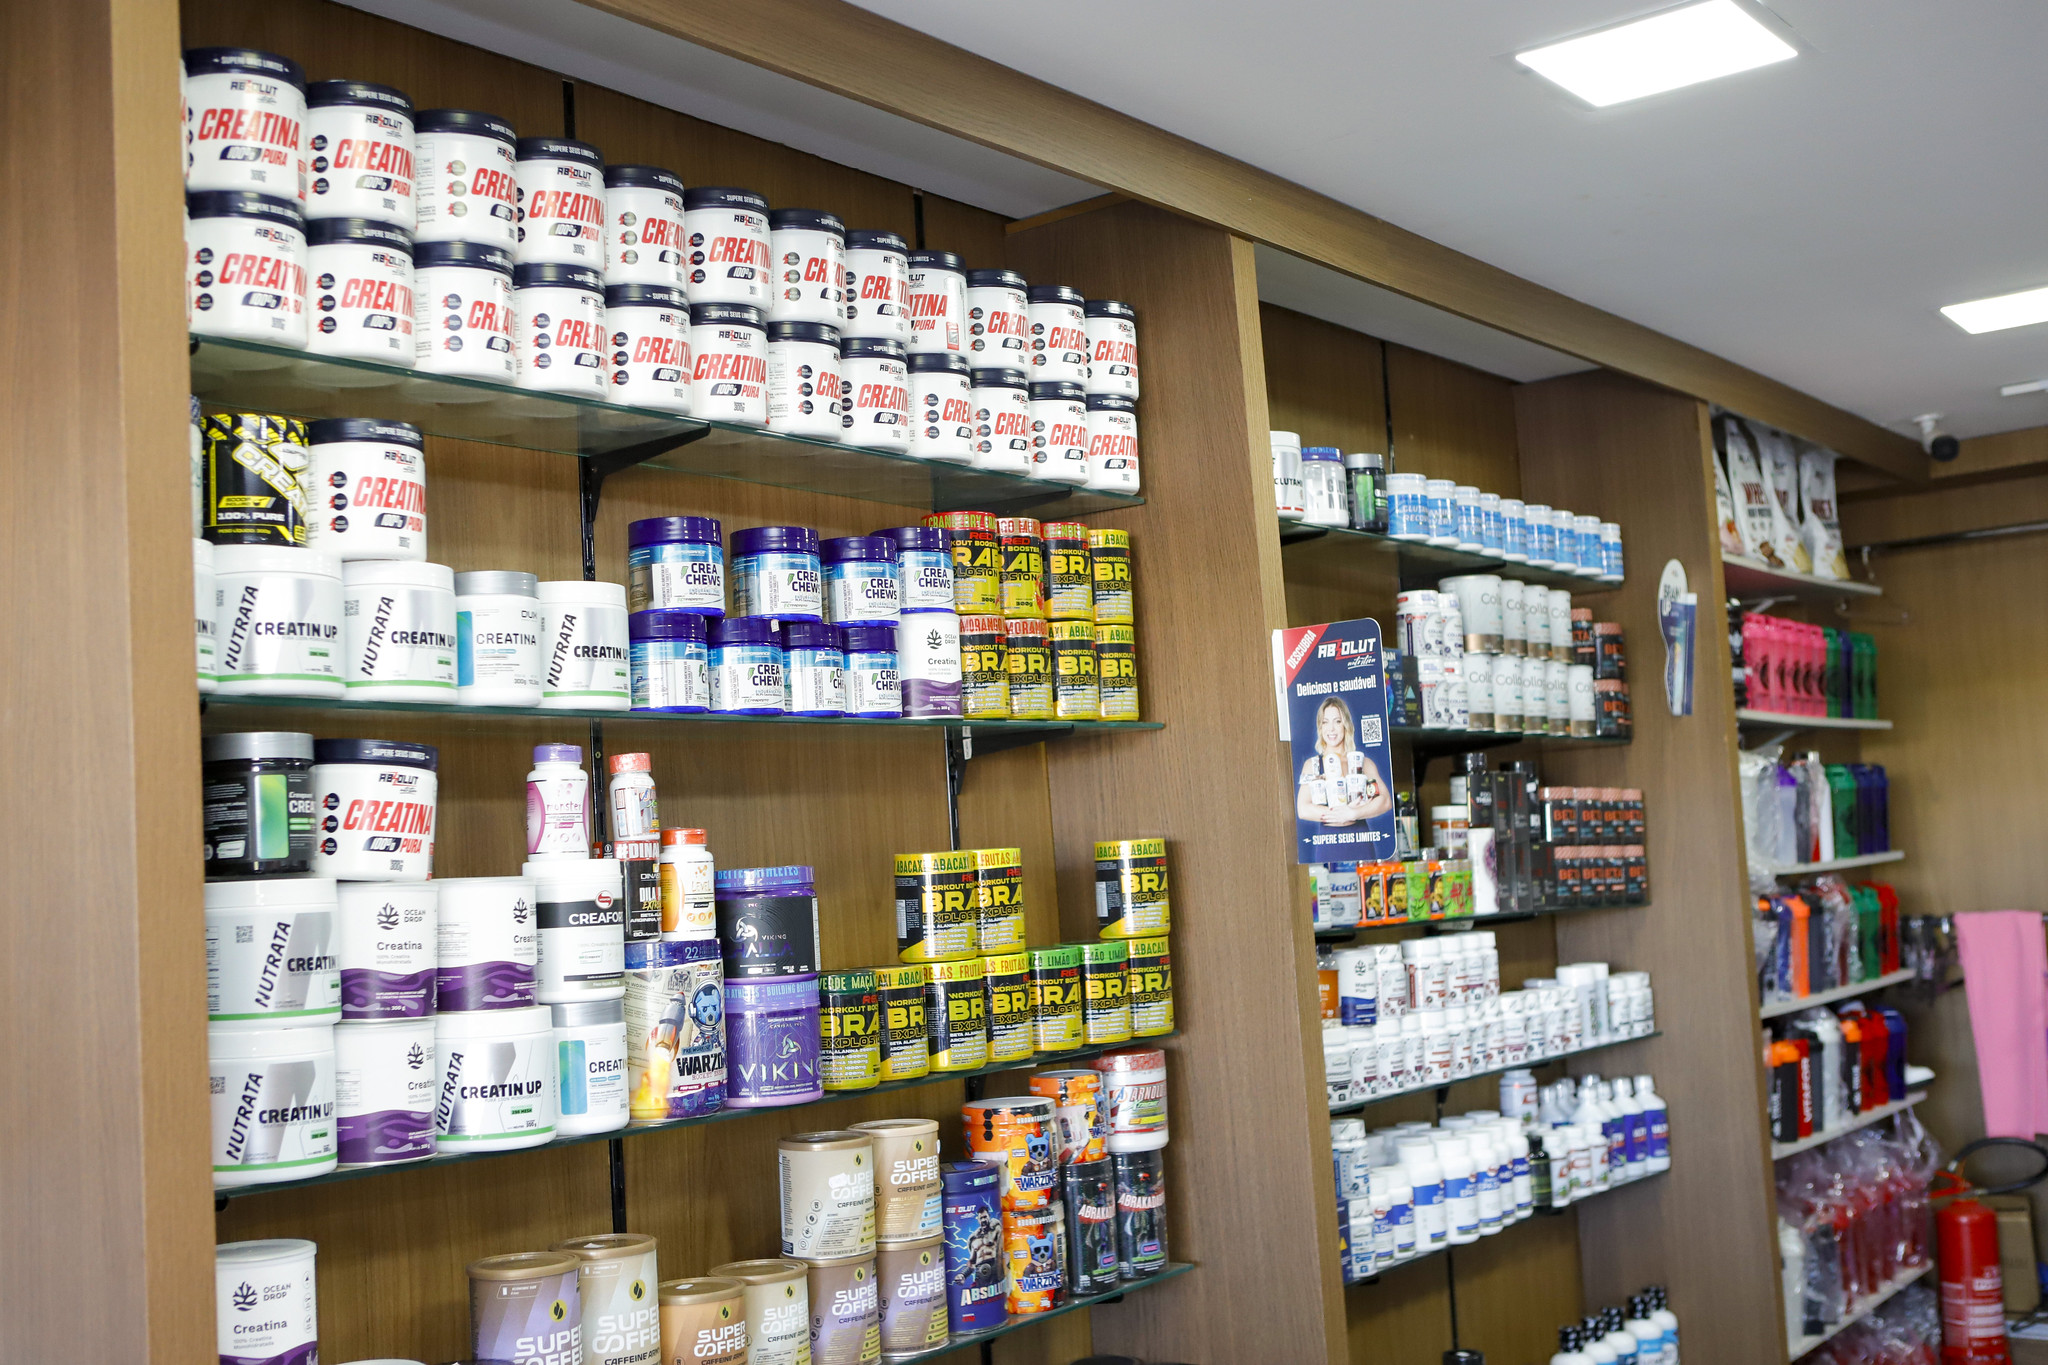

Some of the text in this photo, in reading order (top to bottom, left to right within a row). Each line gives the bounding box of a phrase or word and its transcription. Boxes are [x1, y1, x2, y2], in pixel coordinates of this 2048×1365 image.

[199, 108, 299, 151] CREATINA
[261, 149, 286, 167] PURA
[693, 354, 766, 385] CREATINA
[741, 385, 759, 399] PURA
[217, 512, 285, 521] 100% PURE
[929, 515, 981, 529] CRANBERRY
[969, 532, 993, 540] RED
[691, 563, 717, 574] CREA
[923, 568, 947, 578] CREA
[685, 574, 721, 586] CHEWS
[797, 571, 818, 581] CREA
[919, 578, 950, 588] CHEWS
[792, 581, 820, 593] CHEWS
[870, 579, 894, 588] CREA
[866, 588, 897, 599] CHEWS
[224, 585, 259, 670] NUTRATA
[255, 622, 338, 638] CREATIN UP
[361, 596, 394, 676] NUTRATA
[391, 630, 446, 648] CREATIN
[476, 633, 536, 645] CREATINA
[547, 614, 576, 687] NUTRATA
[574, 645, 621, 659] CREATIN
[1286, 629, 1316, 670] DESCUBRA
[758, 665, 780, 674] CREA
[880, 670, 898, 679] CREA
[753, 675, 782, 686] CHEWS
[876, 680, 901, 690] CHEWS
[1297, 675, 1376, 697] Delicioso e saudável!
[343, 799, 433, 835] CREATINA
[1313, 831, 1380, 845] SUPERE SEUS LIMITES
[400, 839, 422, 853] PURA
[981, 852, 1010, 866] FRUTAS
[377, 942, 422, 951] Creatina
[685, 947, 698, 959] 22
[254, 921, 292, 1009] NUTRATA
[1001, 958, 1026, 973] FRUTAS
[1048, 952, 1070, 966] LIMÃO
[1086, 972, 1117, 980] WORKOUT
[992, 984, 1025, 993] WORKOUT
[436, 1052, 464, 1131] NUTRATA
[461, 1080, 542, 1100] CREATIN UP
[226, 1072, 263, 1160] NUTRATA
[259, 1104, 320, 1124] CREATIN
[893, 1155, 938, 1173] SUPER
[891, 1167, 939, 1185] COFFEE
[897, 1185, 925, 1193] CAFFEINE
[837, 1199, 864, 1208] CAFFEINE
[901, 1267, 944, 1286] SUPER
[263, 1283, 291, 1293] OCEAN
[897, 1281, 945, 1298] COFFEE
[263, 1291, 287, 1301] DROP
[904, 1298, 932, 1306] CAFFEINE
[839, 1314, 865, 1324] CAFFEINE
[233, 1320, 287, 1334] Creatina
[697, 1320, 746, 1340] SUPER
[767, 1332, 796, 1343] CAFFEINE
[693, 1335, 746, 1358] COFFEE
